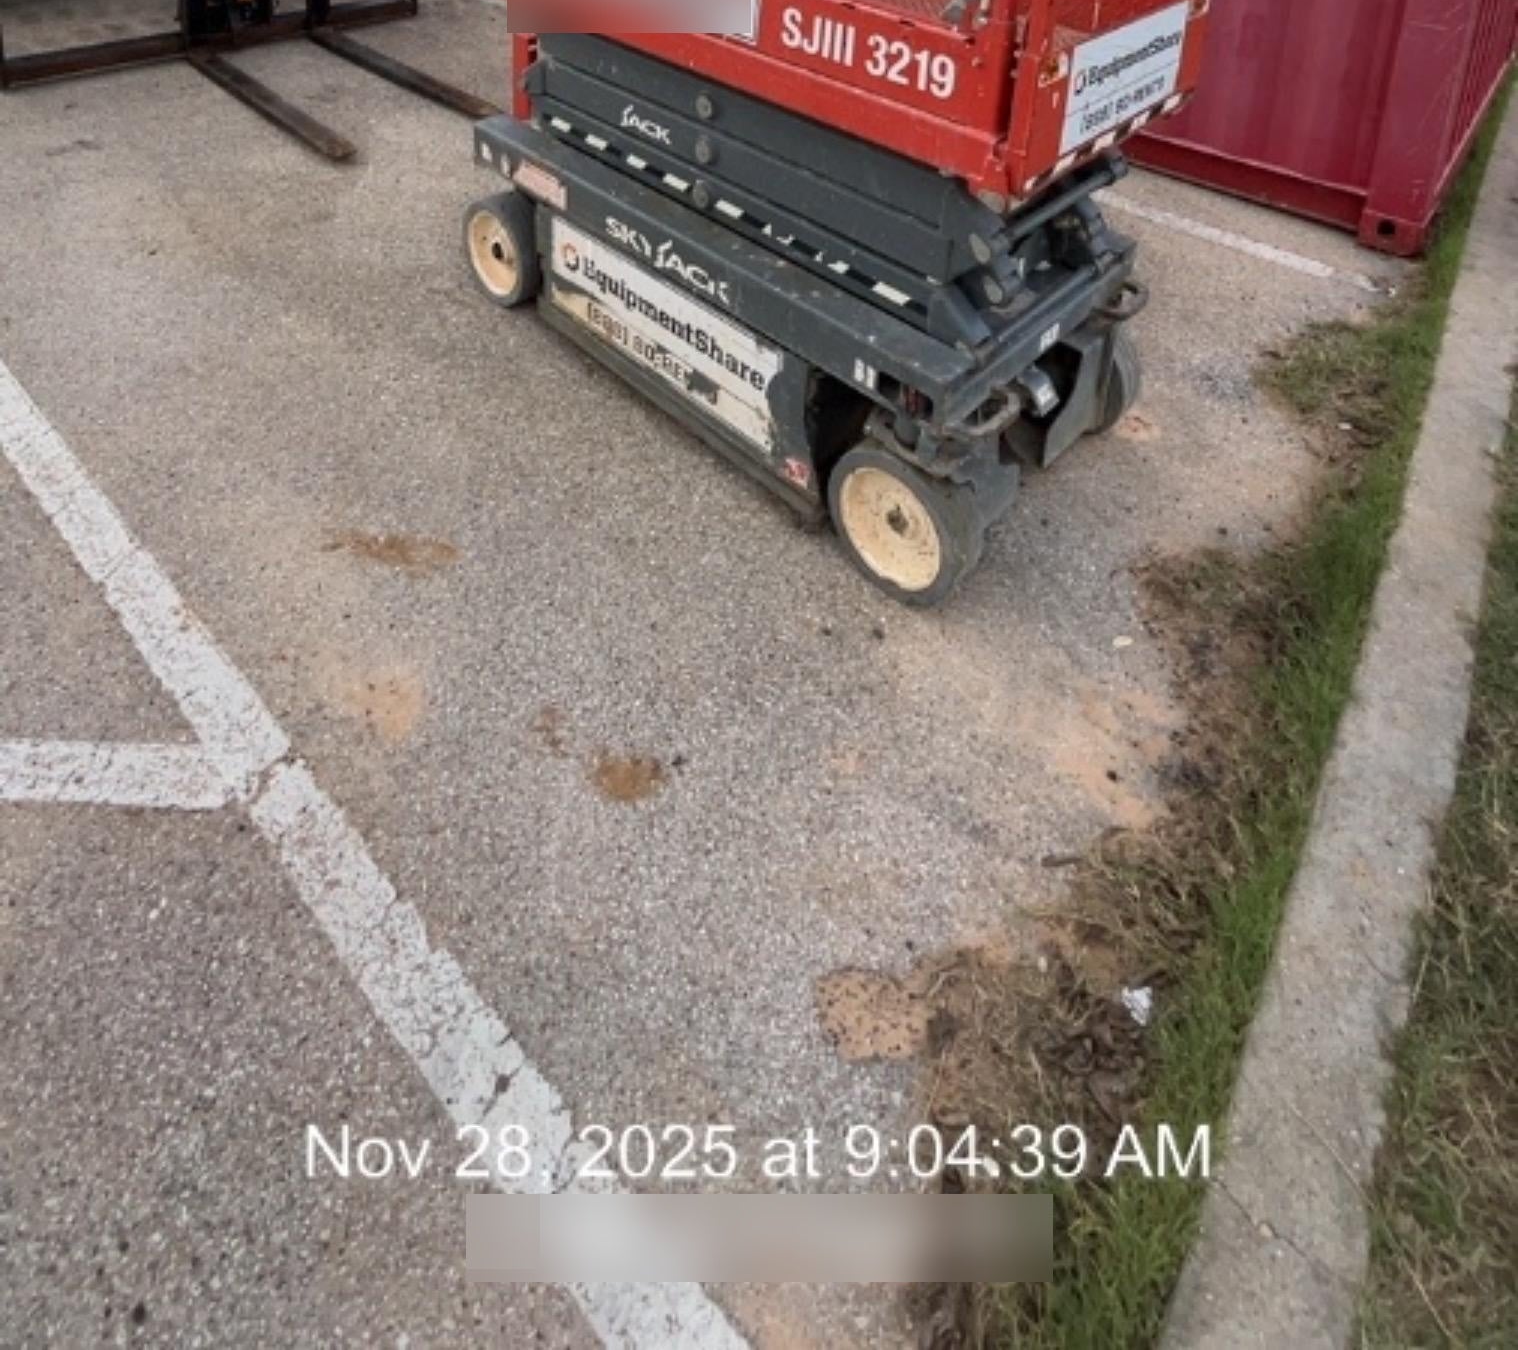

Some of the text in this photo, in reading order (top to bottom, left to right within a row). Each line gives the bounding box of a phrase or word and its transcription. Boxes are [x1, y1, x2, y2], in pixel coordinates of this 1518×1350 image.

[864, 34, 956, 99] 3219
[620, 104, 672, 145] JACK
[604, 215, 731, 306] SKYJACK
[583, 256, 766, 392] EquipmentShare
